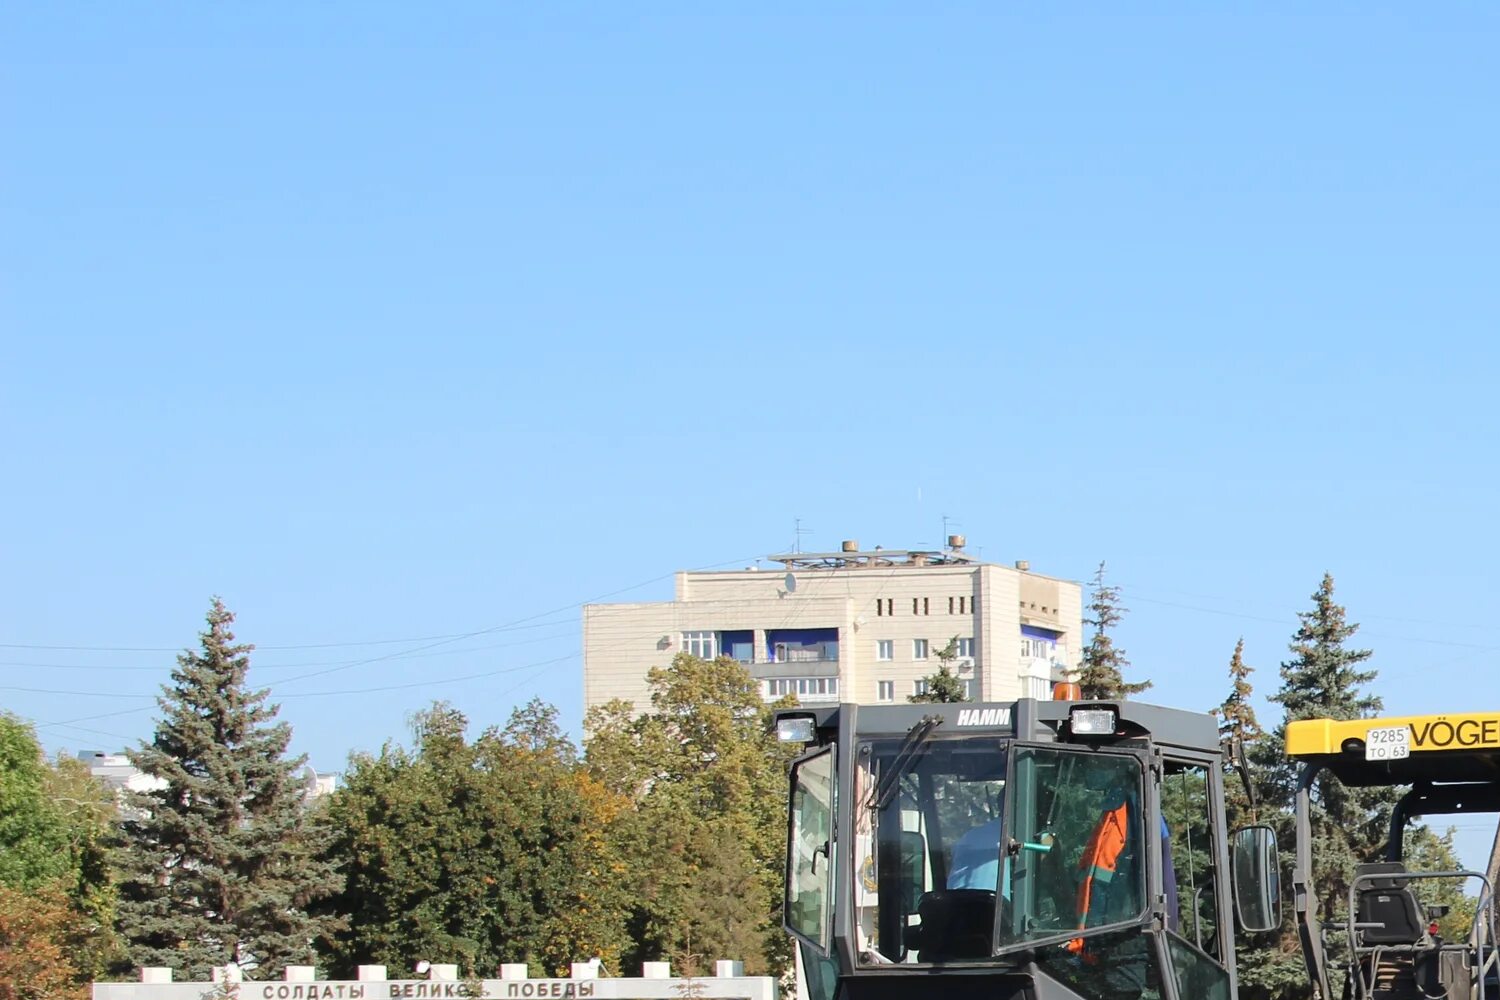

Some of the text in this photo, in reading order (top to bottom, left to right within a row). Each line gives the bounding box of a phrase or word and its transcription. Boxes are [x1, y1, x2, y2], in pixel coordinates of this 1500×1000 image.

[957, 708, 1011, 726] HAMM
[1371, 729, 1405, 743] 9285
[1392, 747, 1406, 757] 63
[263, 982, 594, 1000] СОЛДАТЫ ВЕЛИКО ПОБЕДЫ
